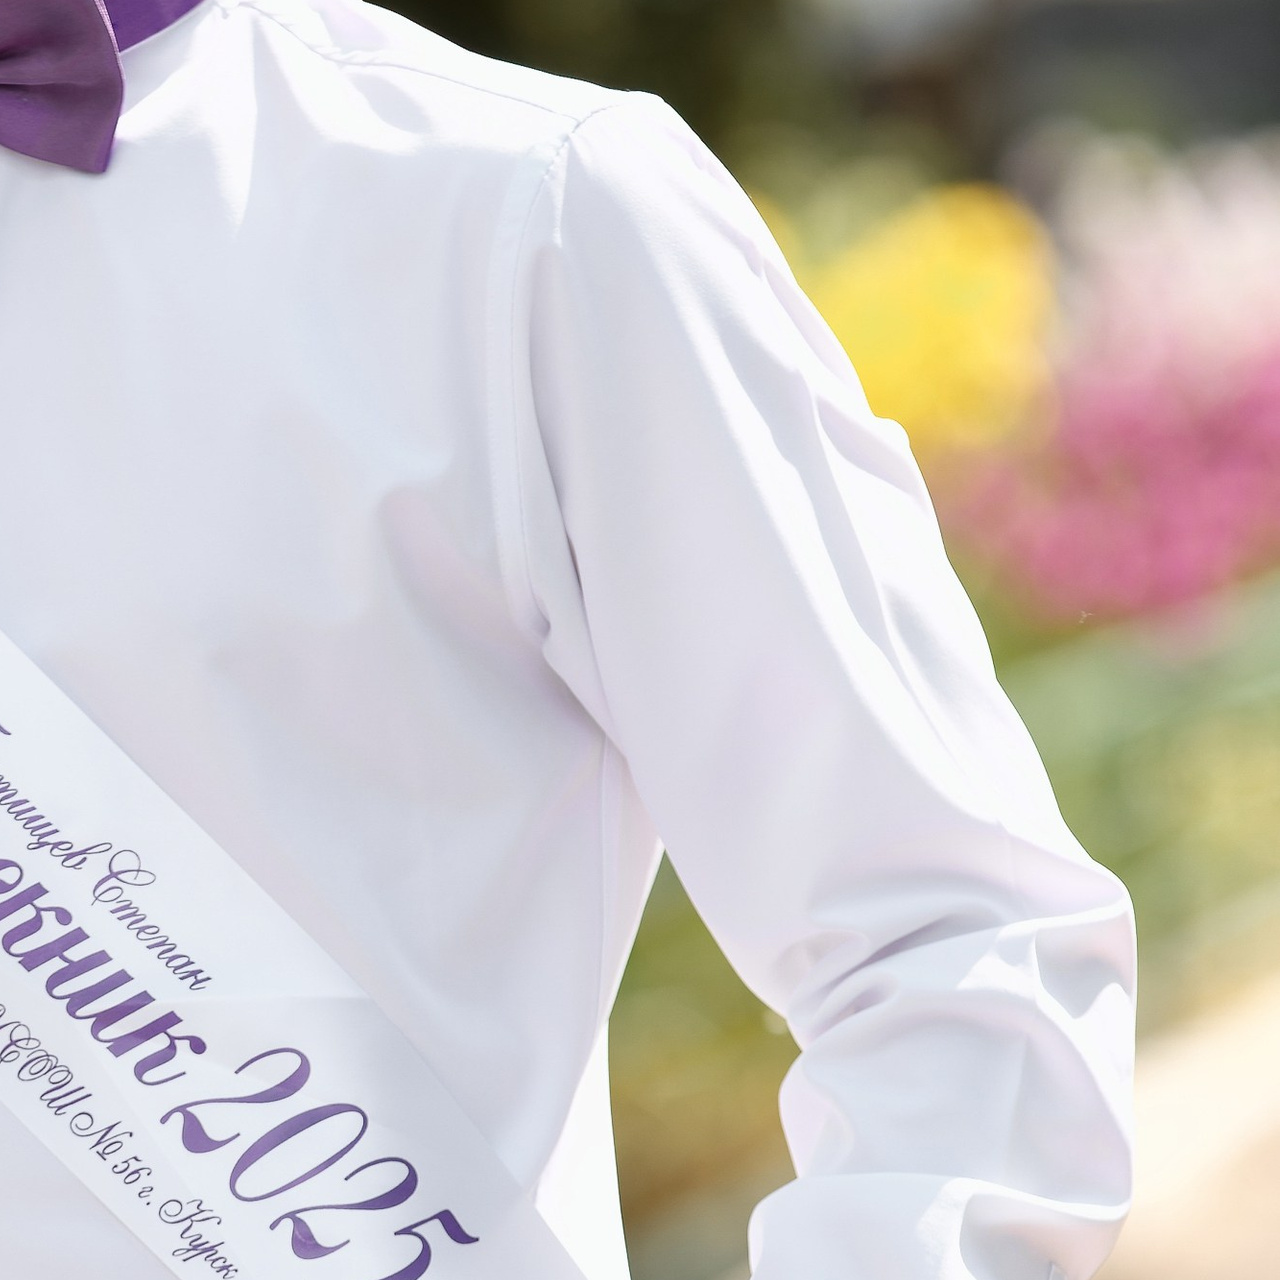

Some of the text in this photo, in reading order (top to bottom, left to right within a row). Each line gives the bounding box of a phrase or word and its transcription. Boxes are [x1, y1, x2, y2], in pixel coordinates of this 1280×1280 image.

[91, 849, 212, 990] Степан
[69, 1111, 133, 1162] №
[111, 1155, 153, 1186] 56
[138, 1186, 154, 1206] г.
[158, 1199, 239, 1280] Курск
